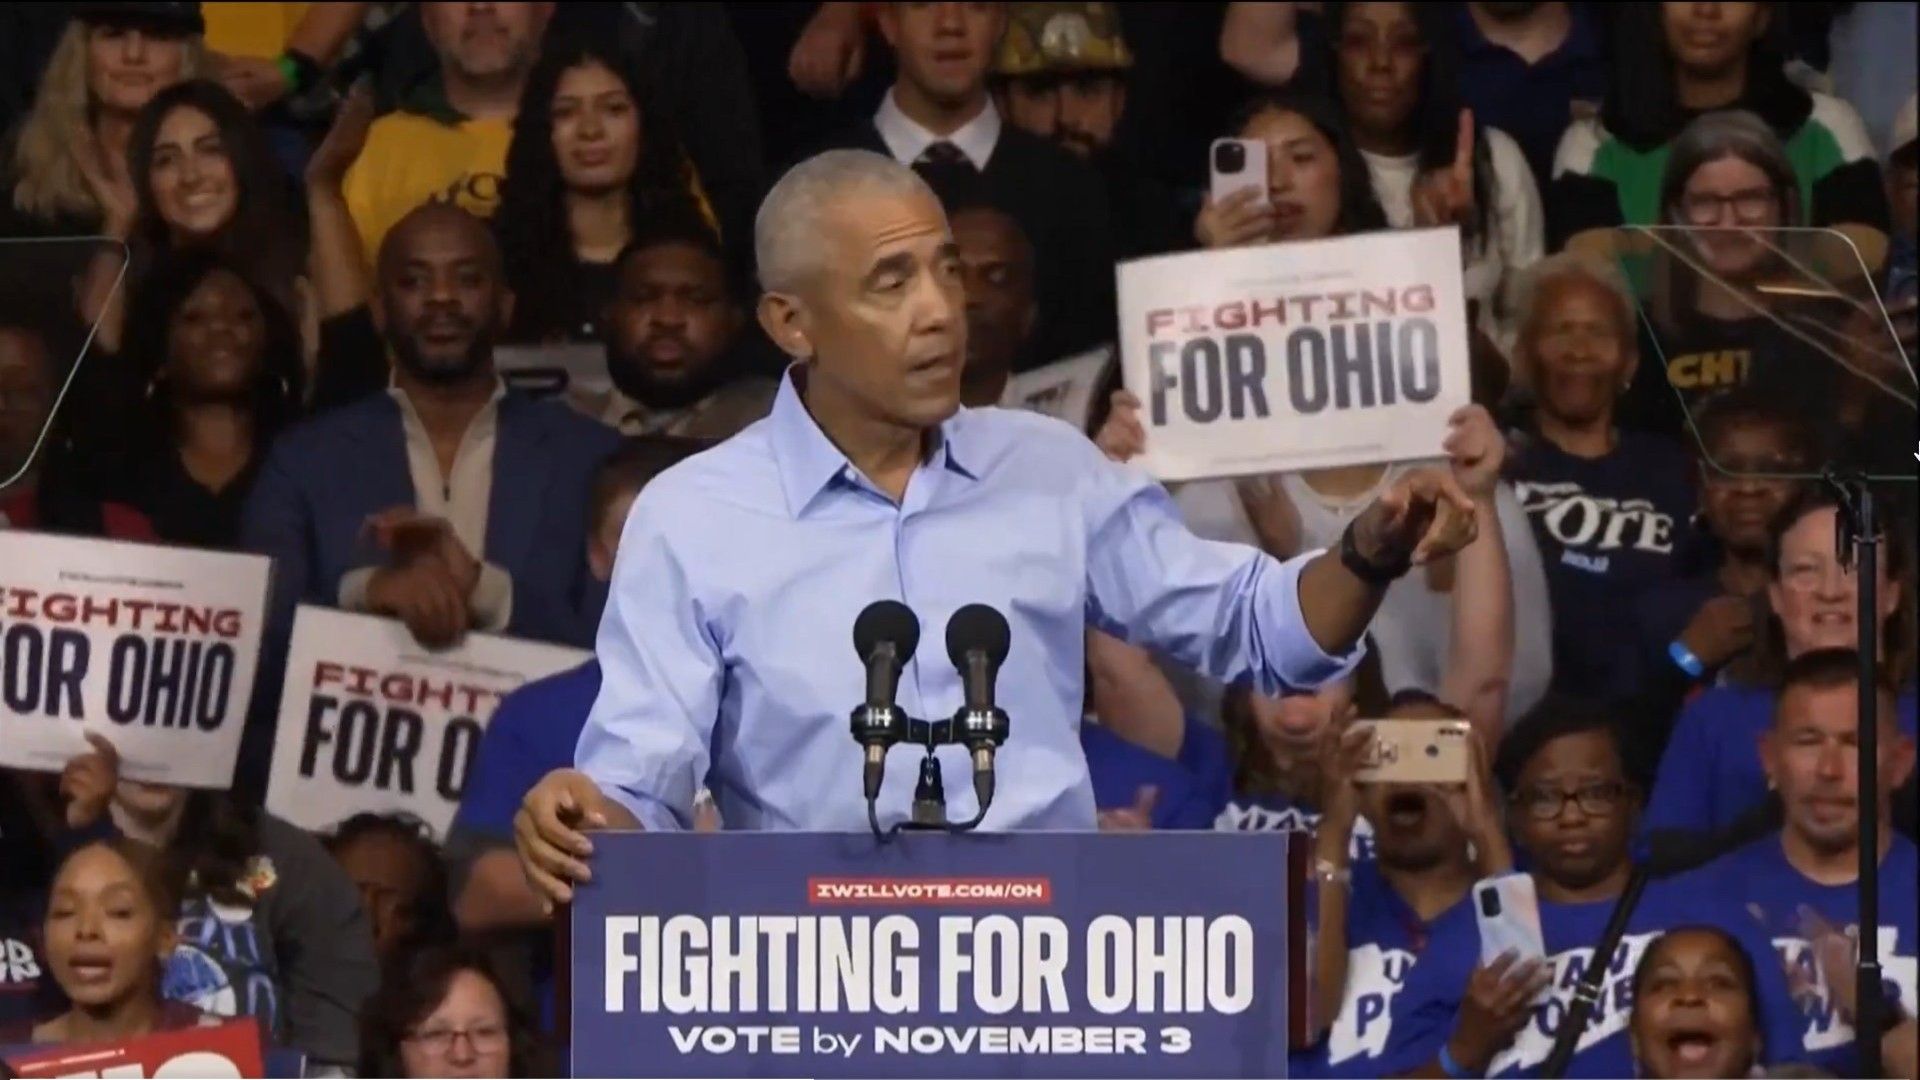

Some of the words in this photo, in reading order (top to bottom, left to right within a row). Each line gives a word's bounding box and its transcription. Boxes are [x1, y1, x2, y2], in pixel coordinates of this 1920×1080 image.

[1146, 284, 1436, 336] FIGHTING
[1149, 331, 1270, 426] FOR
[1286, 317, 1441, 414] OHIO
[0, 587, 243, 638] IGHTING
[0, 621, 91, 719] OR
[106, 633, 235, 731] OHIO
[313, 661, 502, 714] FIGHT
[299, 693, 424, 794] FOR
[817, 883, 1043, 899] IWILLVOTE.COM/OH
[605, 914, 920, 1015] FIGHTING
[938, 914, 1070, 1015] FOR
[1086, 914, 1254, 1015] OHIO
[667, 1026, 801, 1054] VOTE
[813, 1026, 863, 1058] by
[874, 1026, 1147, 1054] NOVEMBER
[1160, 1026, 1192, 1054] 3
